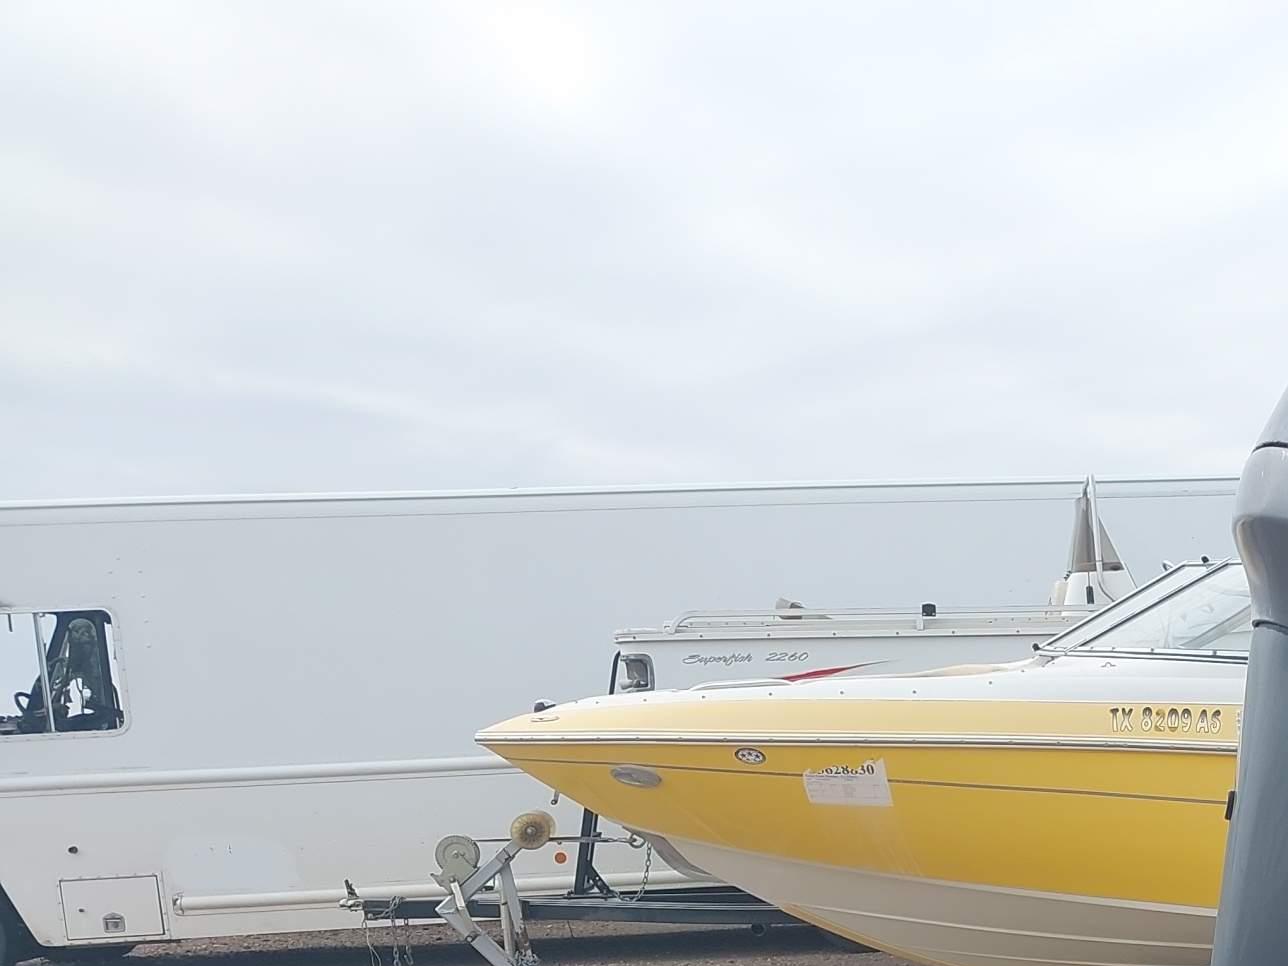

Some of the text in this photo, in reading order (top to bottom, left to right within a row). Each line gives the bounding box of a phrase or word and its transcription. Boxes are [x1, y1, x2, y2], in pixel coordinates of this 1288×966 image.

[681, 652, 809, 666] Superfish 2260
[1110, 707, 1222, 734] TX 8209 AS
